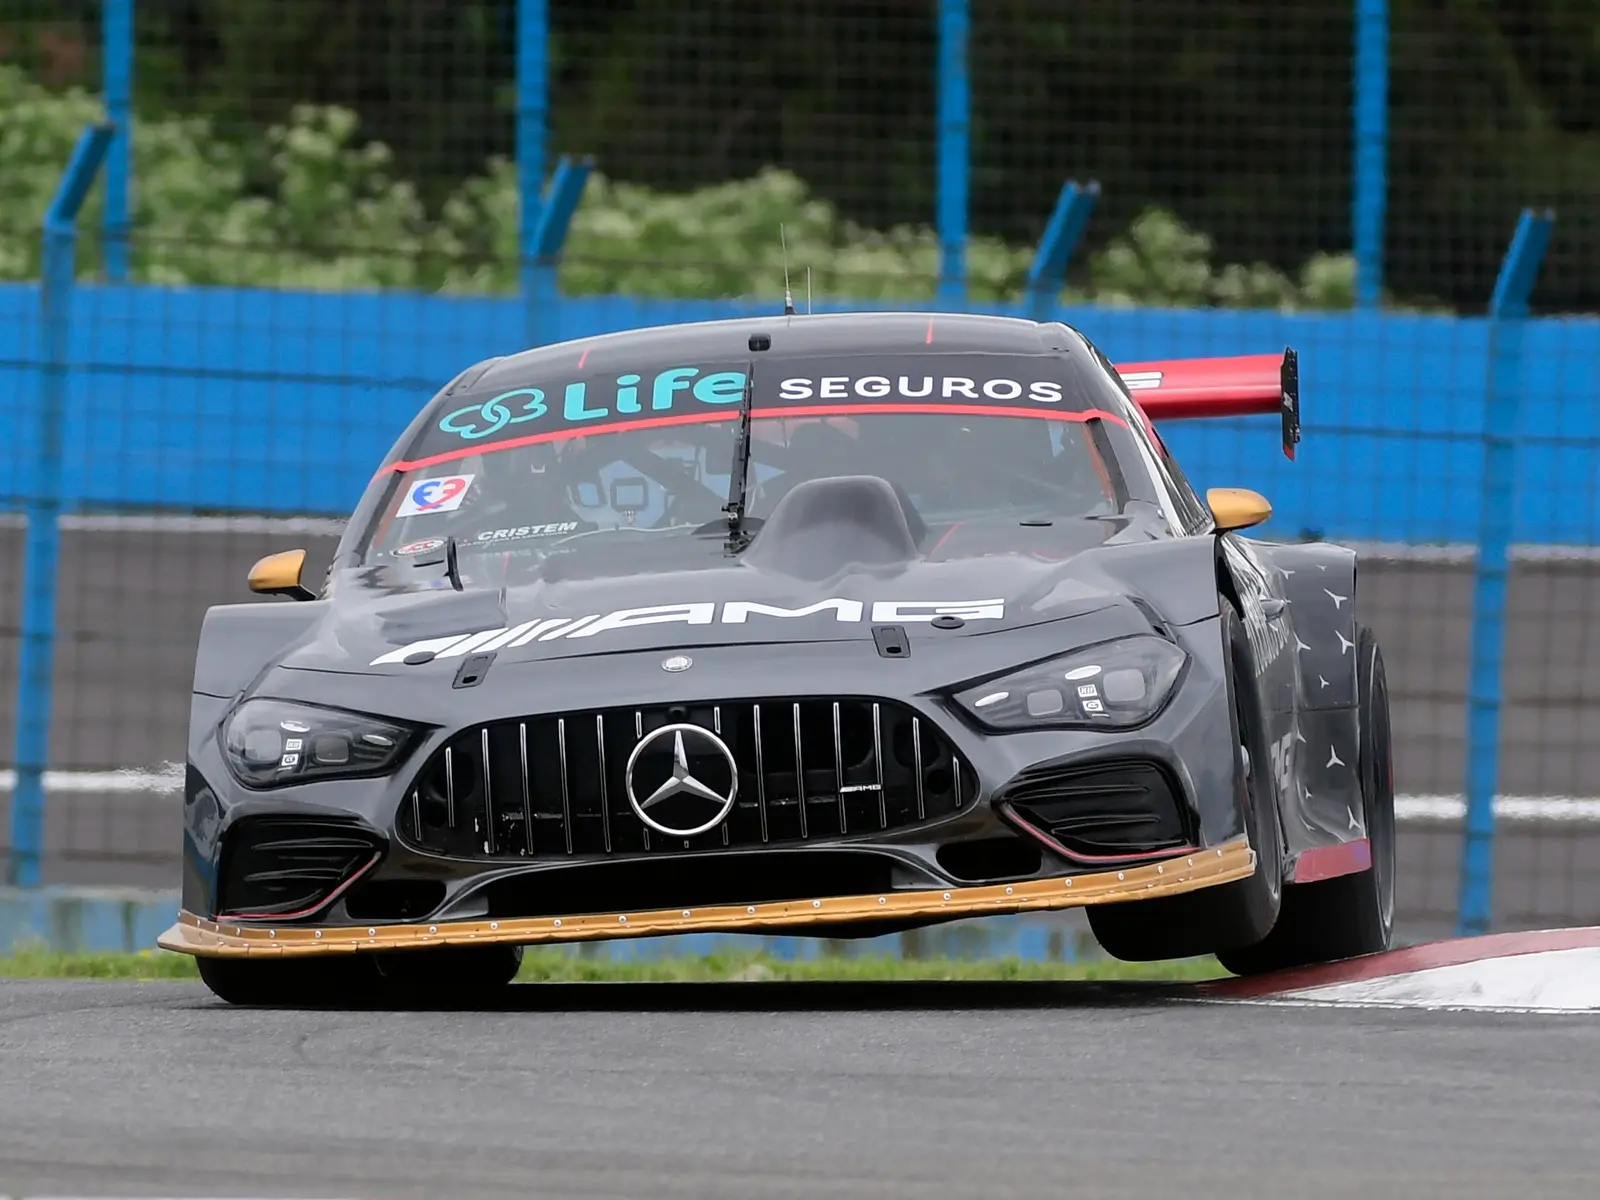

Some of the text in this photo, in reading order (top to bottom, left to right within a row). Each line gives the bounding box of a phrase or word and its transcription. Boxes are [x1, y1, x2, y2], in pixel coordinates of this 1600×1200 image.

[563, 367, 1063, 421] Life SEGUROS
[477, 521, 578, 541] CRISTEM
[566, 598, 1005, 638] AMG
